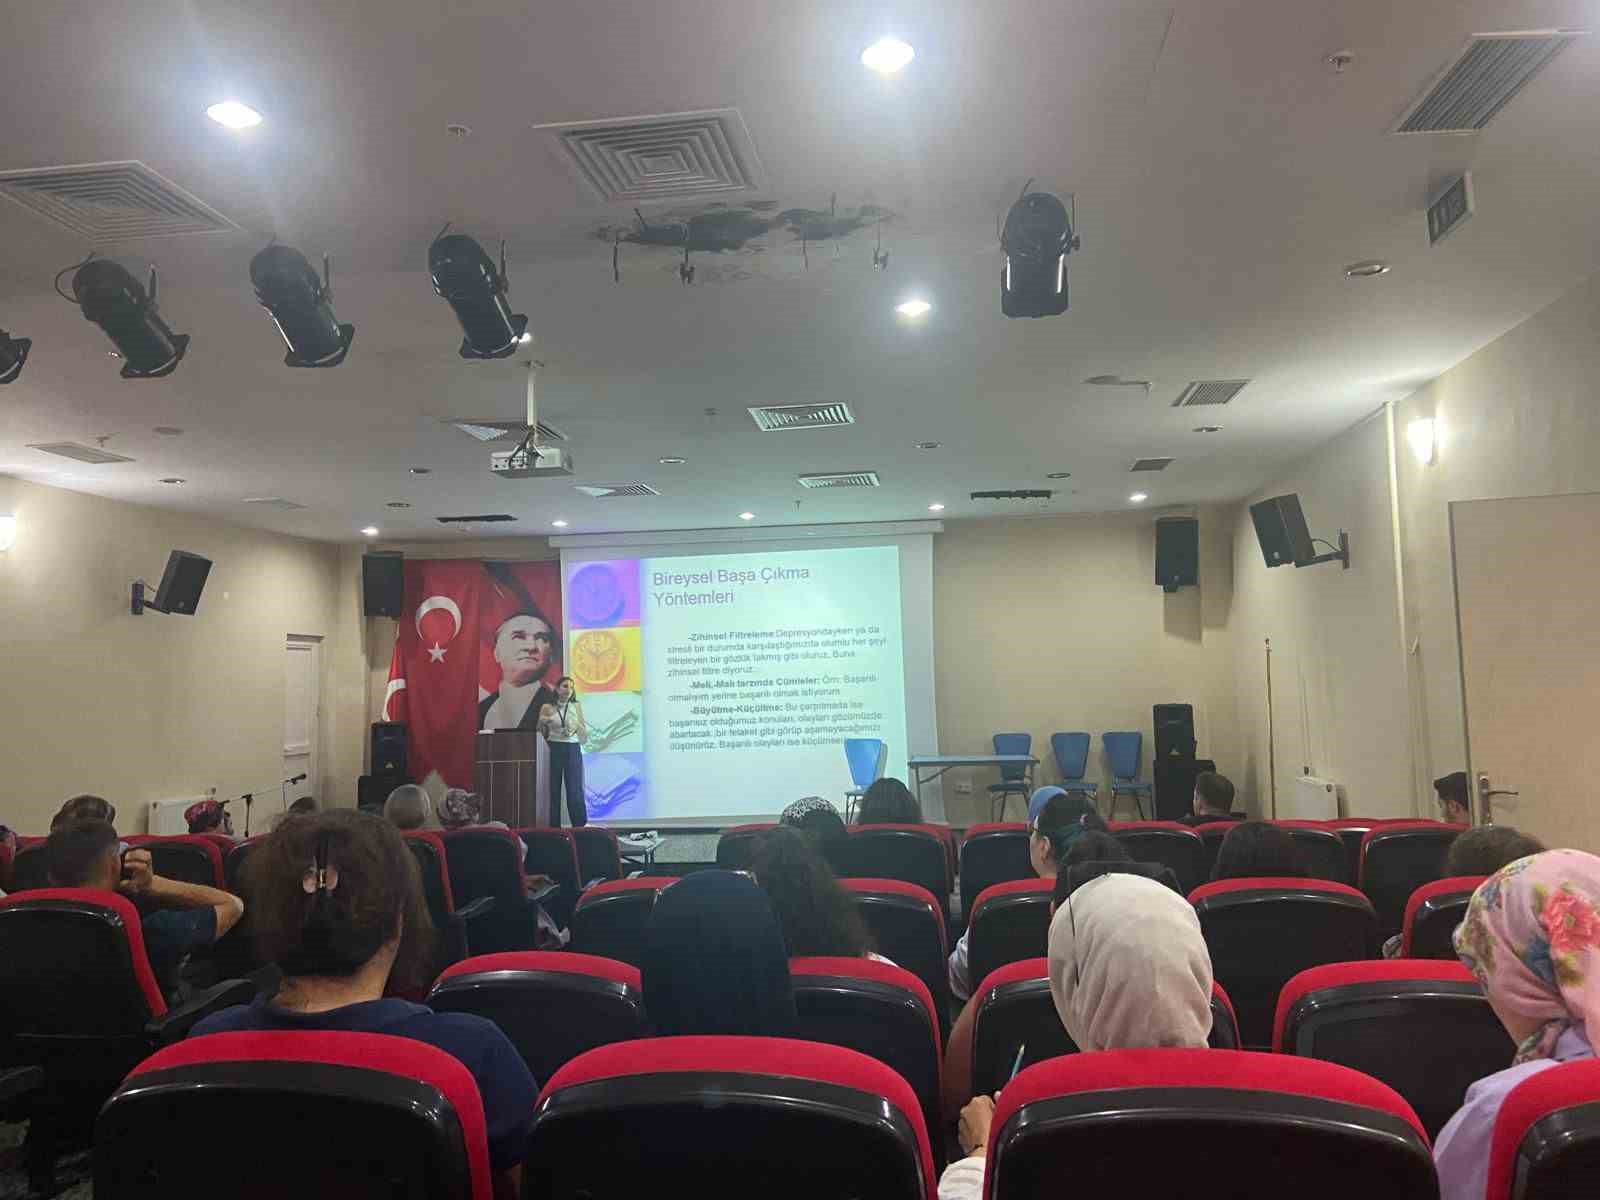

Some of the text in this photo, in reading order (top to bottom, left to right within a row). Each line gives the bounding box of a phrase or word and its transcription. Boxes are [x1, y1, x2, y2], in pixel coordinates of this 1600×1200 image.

[653, 567, 809, 588] Bireysel Başa Çıkma
[653, 590, 734, 607] Yöntemleri
